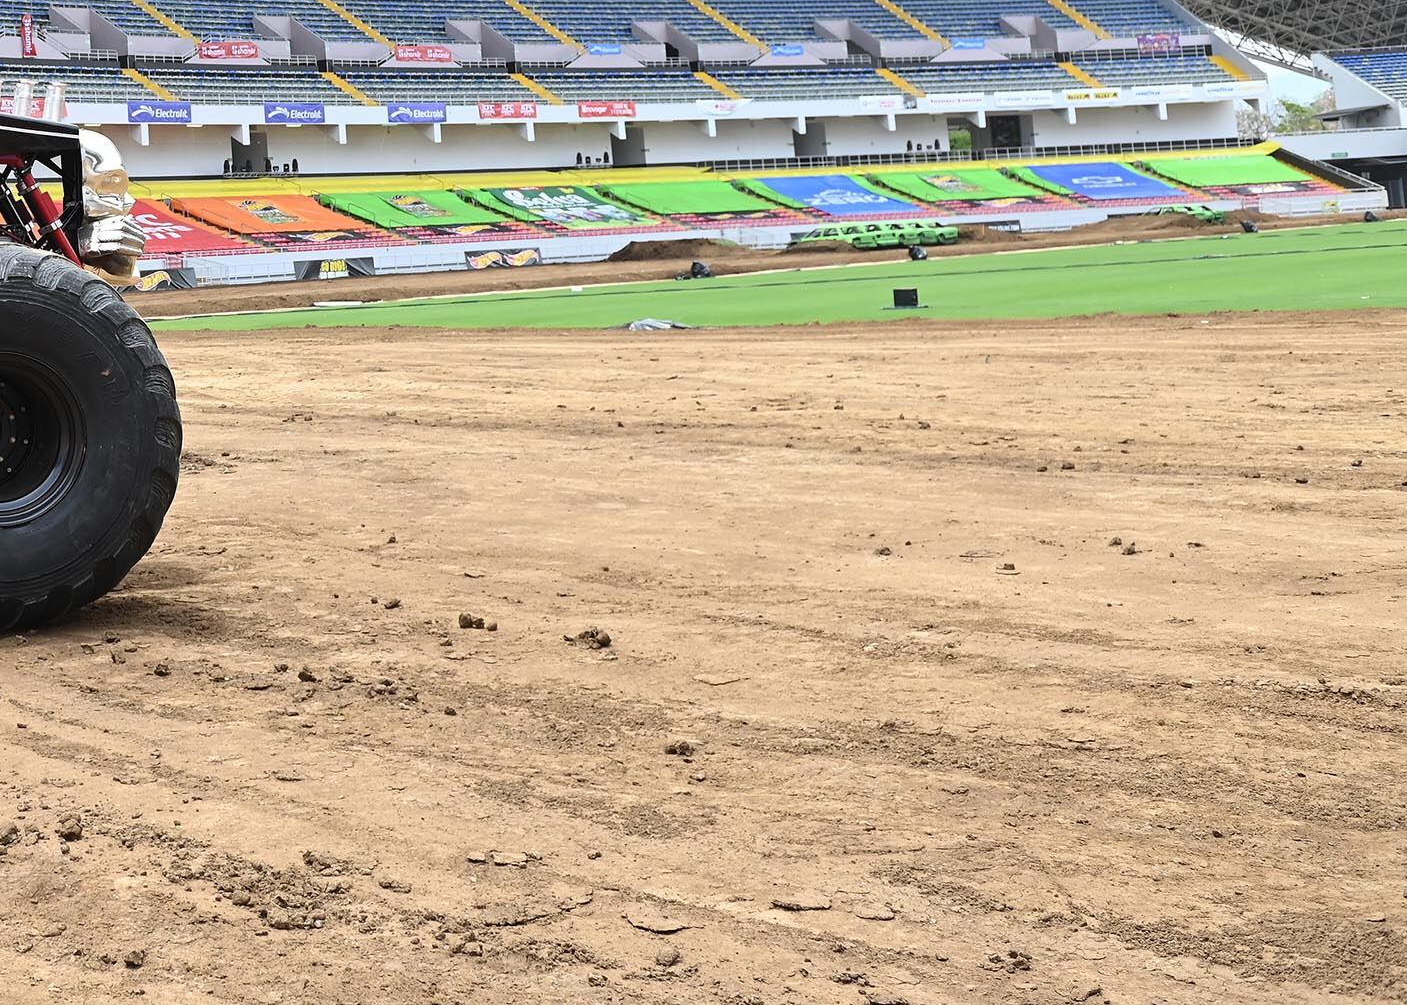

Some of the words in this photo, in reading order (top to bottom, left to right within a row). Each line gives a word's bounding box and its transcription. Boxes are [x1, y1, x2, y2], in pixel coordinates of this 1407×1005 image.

[155, 108, 189, 118] Electrolit
[290, 109, 322, 119] Electrolit
[413, 109, 444, 119] Electrolit
